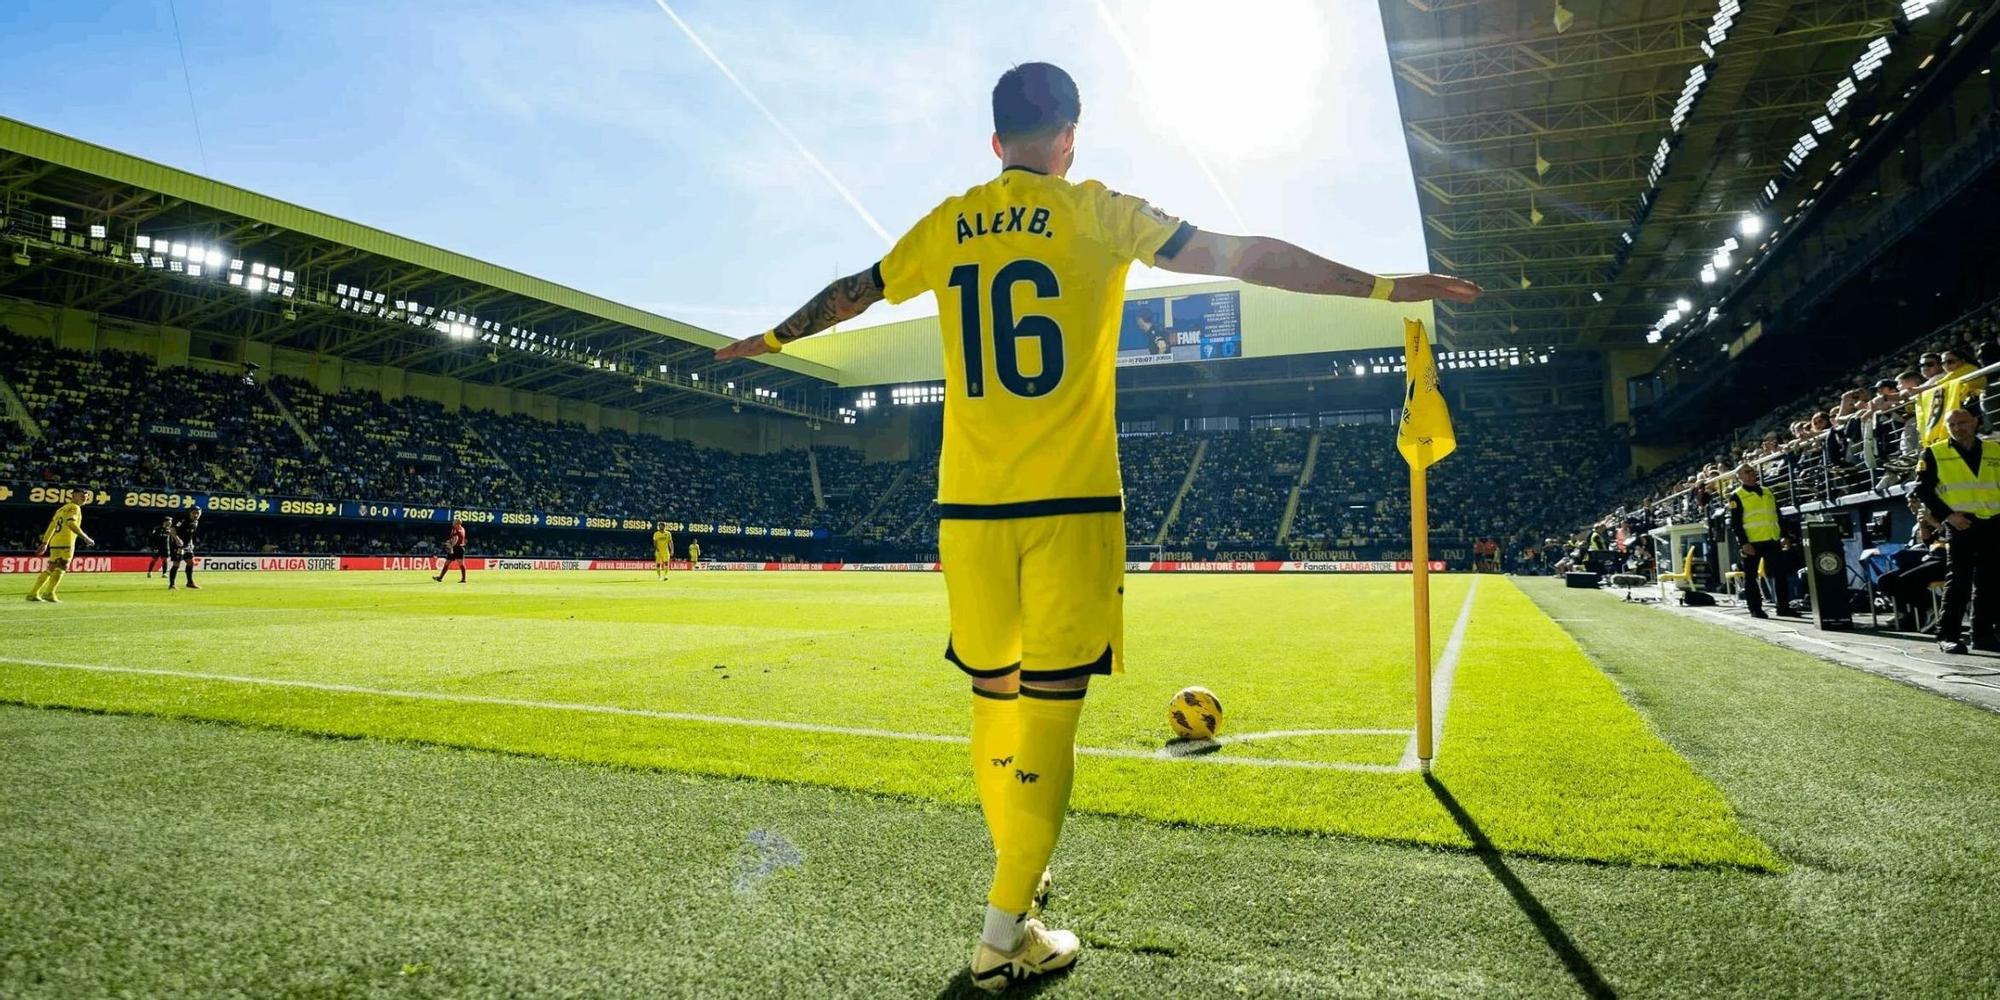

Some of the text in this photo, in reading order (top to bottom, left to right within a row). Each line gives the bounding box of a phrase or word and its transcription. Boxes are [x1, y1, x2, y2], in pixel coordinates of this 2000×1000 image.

[948, 259, 1065, 399] 16
[125, 492, 180, 508] asisa
[208, 496, 257, 512] asisa
[280, 500, 324, 515] asisa
[370, 506, 435, 519] 0-0 70:07
[453, 510, 486, 522] asisa
[501, 512, 531, 525] asisa
[545, 515, 573, 526] asisa
[586, 517, 611, 528] asisa
[622, 519, 646, 530] asisa
[688, 523, 709, 533] asisa
[1215, 551, 1267, 561] ARGENTA
[1382, 549, 1413, 561] altadi
[1, 557, 112, 572] STO.COM
[203, 558, 336, 570] Fanatics LALIGA STORE
[383, 557, 432, 570] LALIGA
[499, 560, 531, 570] Fanatics
[533, 561, 561, 570] LALIGA
[1176, 562, 1255, 571] LALIGASTORE.COM
[1303, 562, 1337, 571] Fanatics
[1339, 562, 1370, 571] LALIGA
